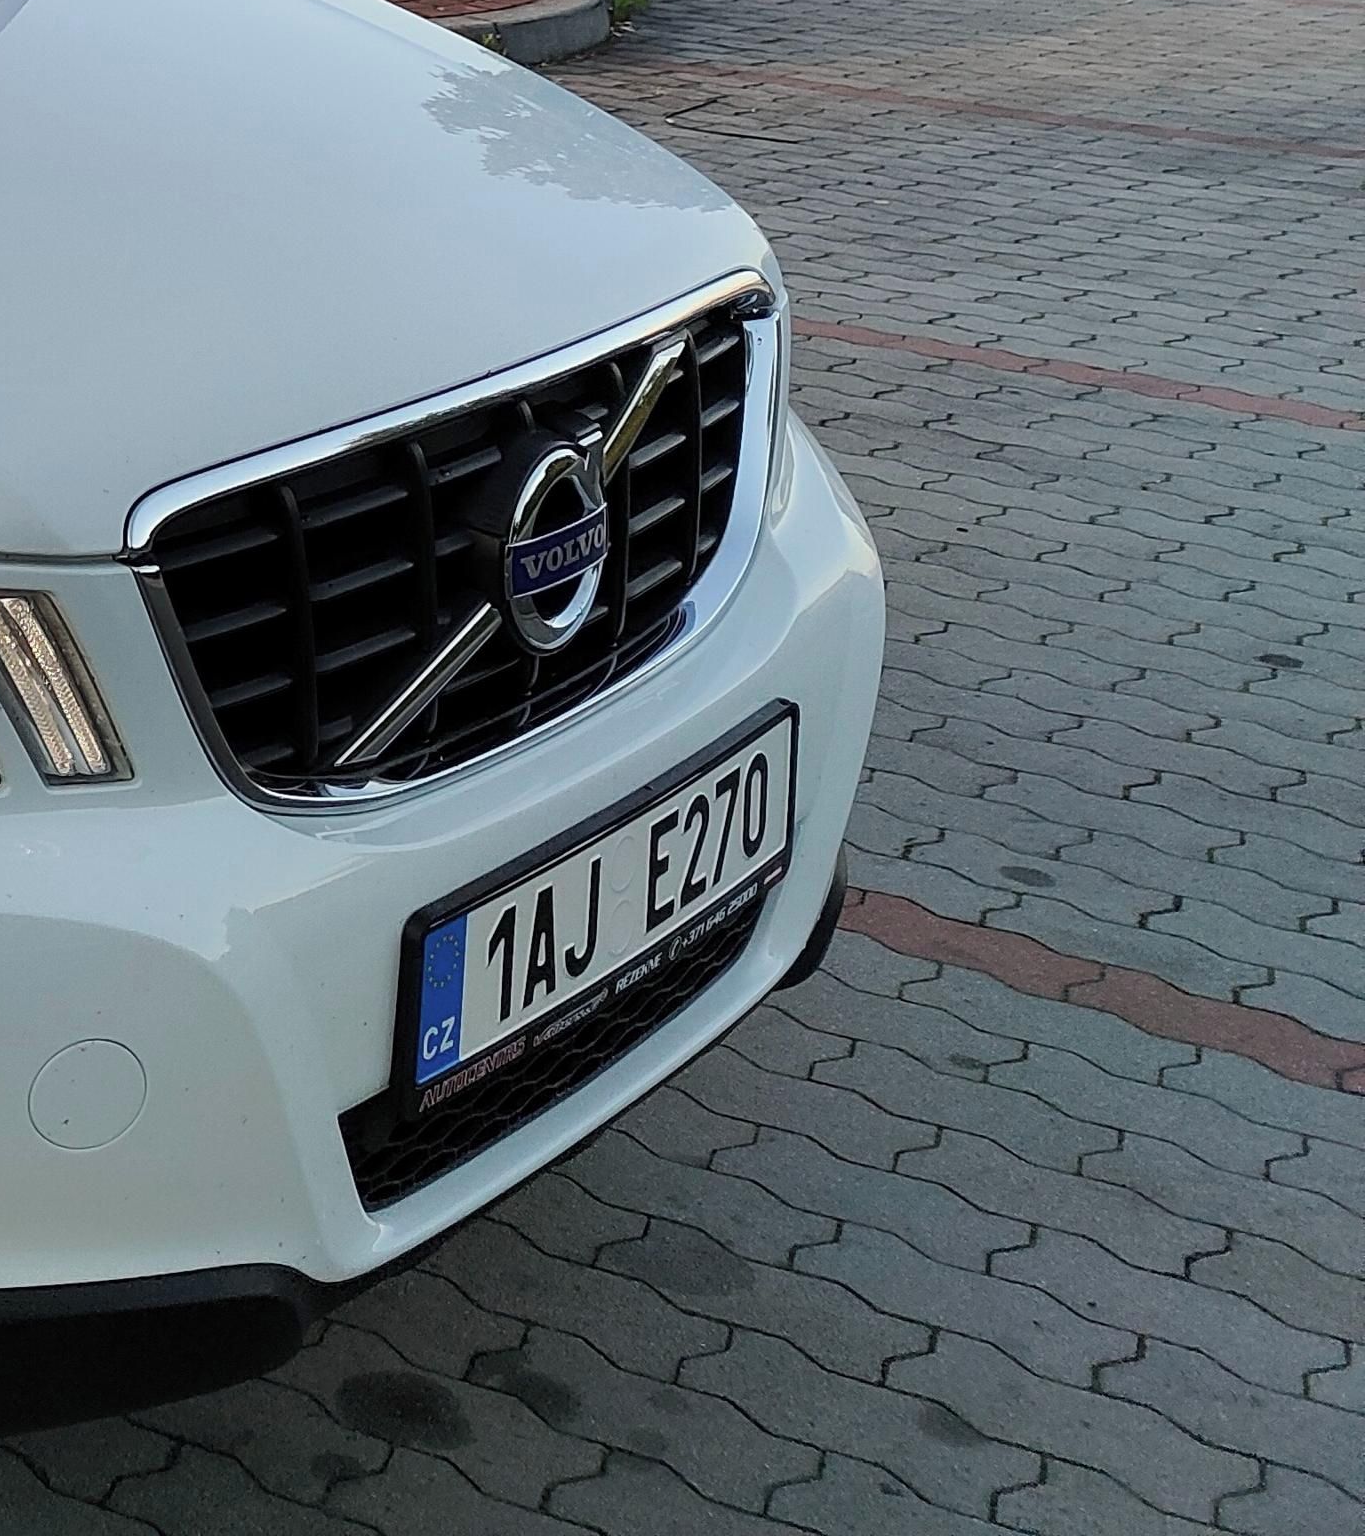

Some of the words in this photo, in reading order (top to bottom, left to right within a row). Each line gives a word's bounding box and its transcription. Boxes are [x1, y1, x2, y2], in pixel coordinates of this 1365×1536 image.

[520, 522, 605, 581] VOLVO
[486, 855, 602, 1024] 1AJ
[645, 751, 769, 934] E270
[423, 1015, 457, 1060] CZ
